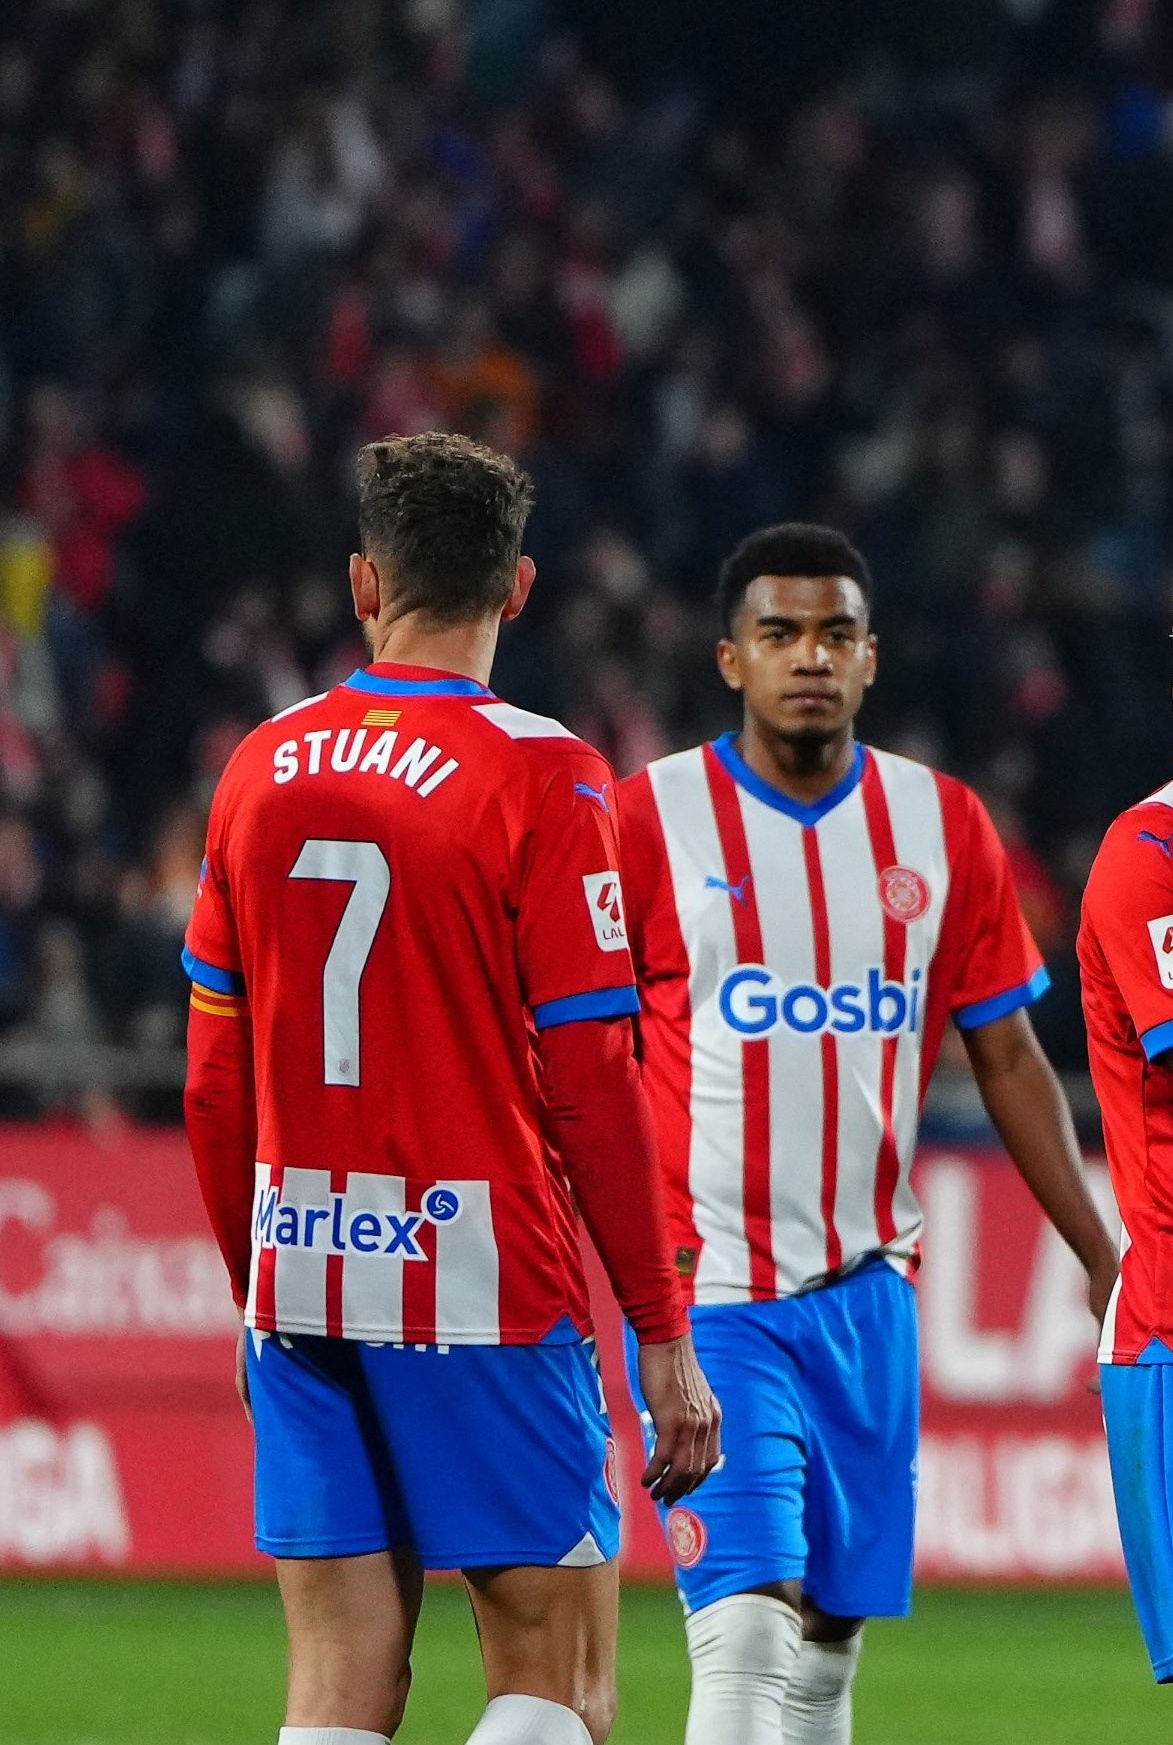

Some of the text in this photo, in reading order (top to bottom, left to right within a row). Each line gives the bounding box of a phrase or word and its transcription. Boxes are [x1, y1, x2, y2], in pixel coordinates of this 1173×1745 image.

[273, 729, 459, 799] STUANI
[289, 838, 391, 1087] 7
[720, 967, 922, 1033] Gosbi
[255, 1189, 420, 1256] Marlex
